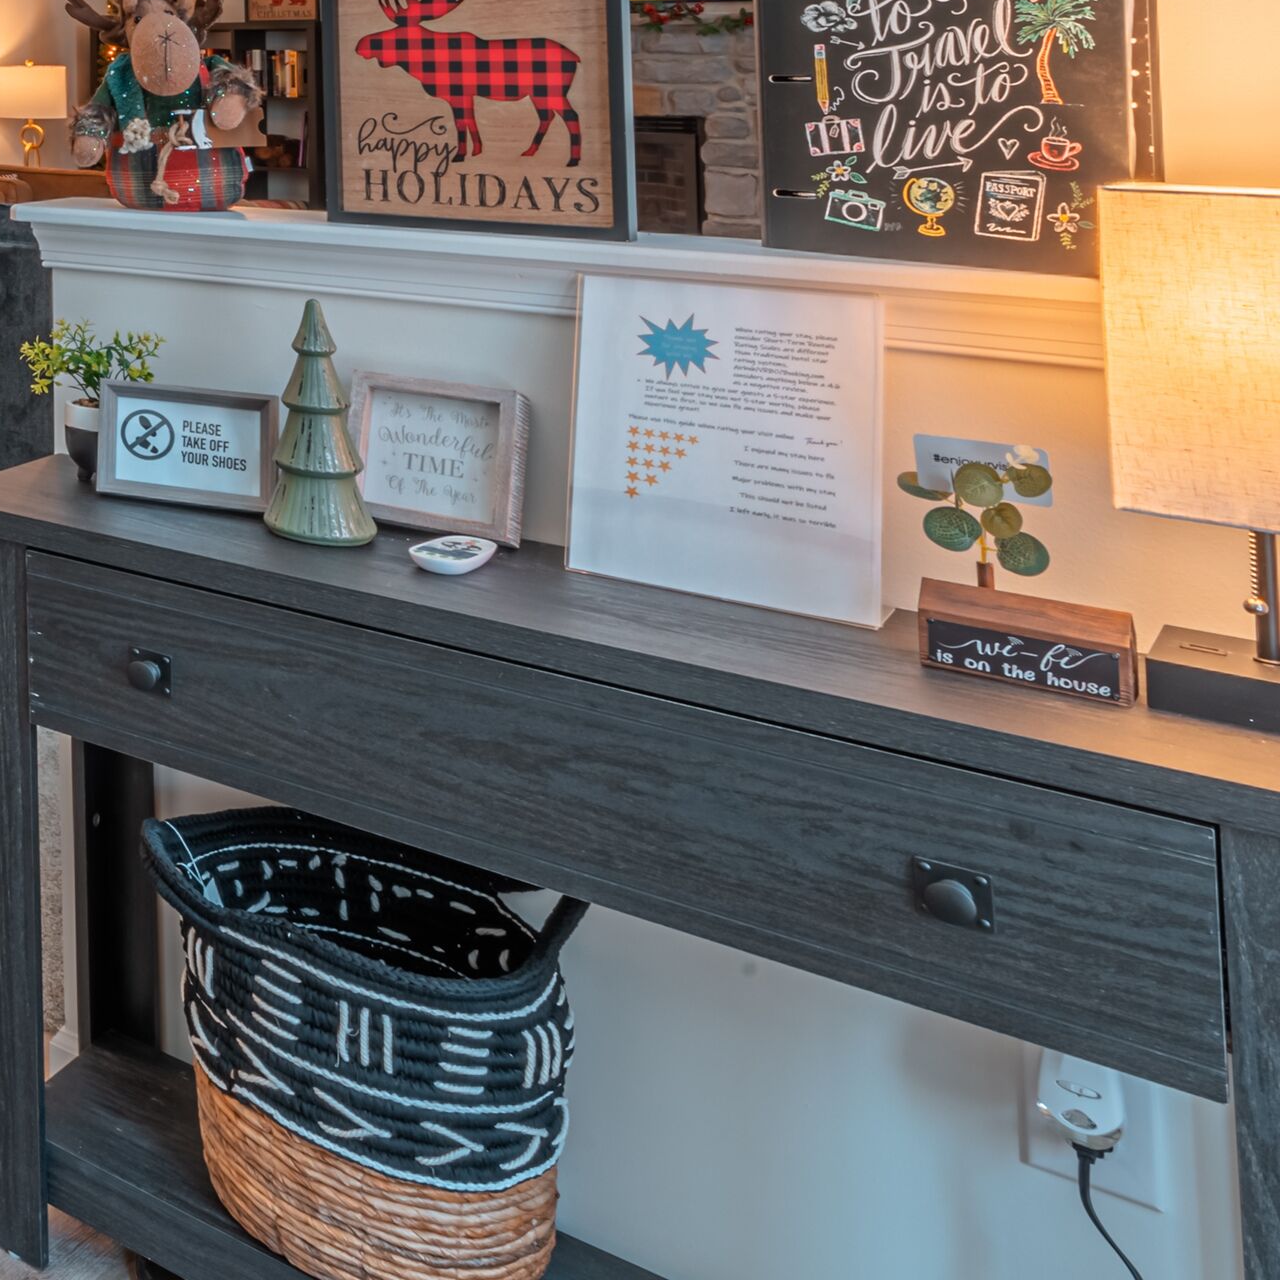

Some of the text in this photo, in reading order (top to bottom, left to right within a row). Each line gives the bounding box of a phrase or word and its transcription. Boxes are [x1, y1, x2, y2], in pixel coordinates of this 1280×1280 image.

[916, 63, 1028, 117] is to
[358, 112, 458, 178] happy
[866, 105, 1042, 174] live
[362, 169, 600, 214] HOLIDAYS
[985, 181, 1037, 197] PASSPORT
[181, 435, 230, 453] TAKE OFF
[182, 420, 221, 436] PLEASE
[378, 424, 495, 461] Wonderful
[181, 451, 247, 472] YOUR SHOES
[403, 452, 465, 478] TIME
[936, 649, 1111, 697] is on the house
